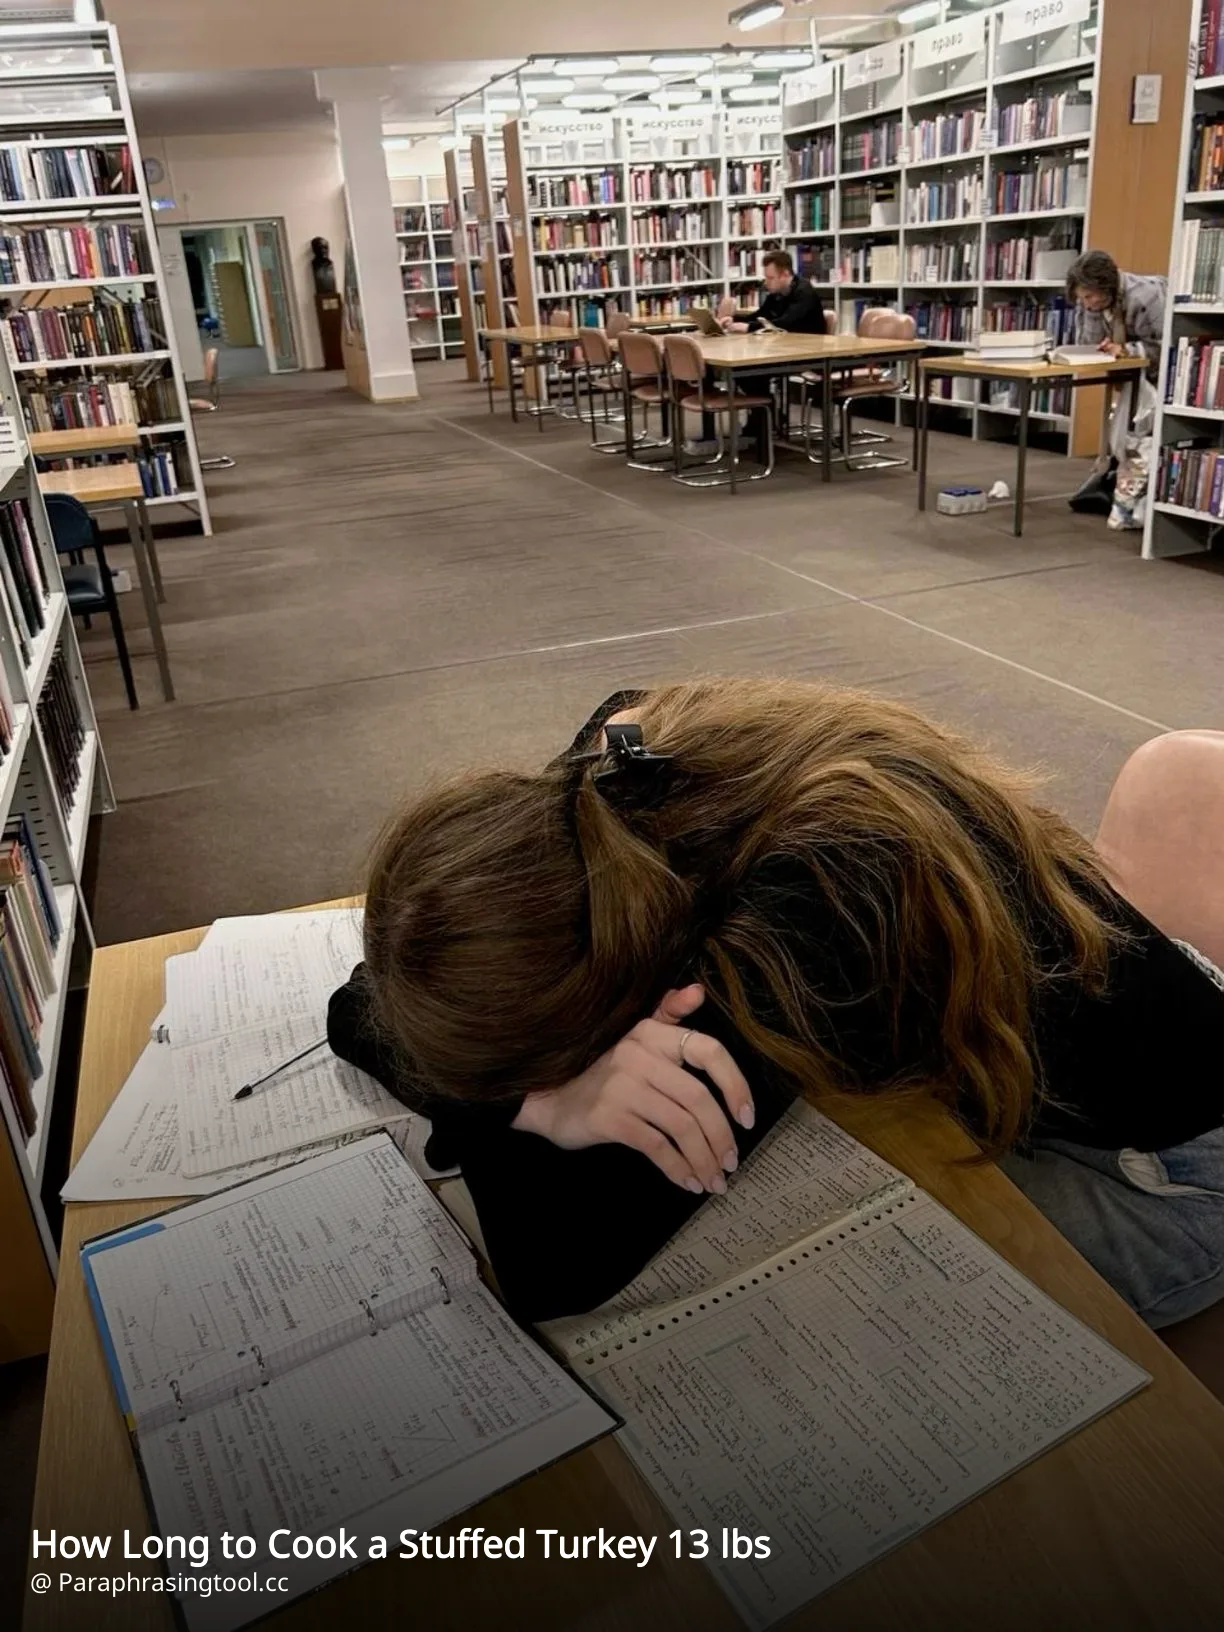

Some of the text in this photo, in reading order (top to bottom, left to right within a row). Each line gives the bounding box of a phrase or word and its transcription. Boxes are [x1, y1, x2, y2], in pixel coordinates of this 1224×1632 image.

[1024, 1, 1064, 27] право
[931, 32, 963, 53] право
[539, 122, 604, 135] искусство
[642, 118, 704, 130] искусство
